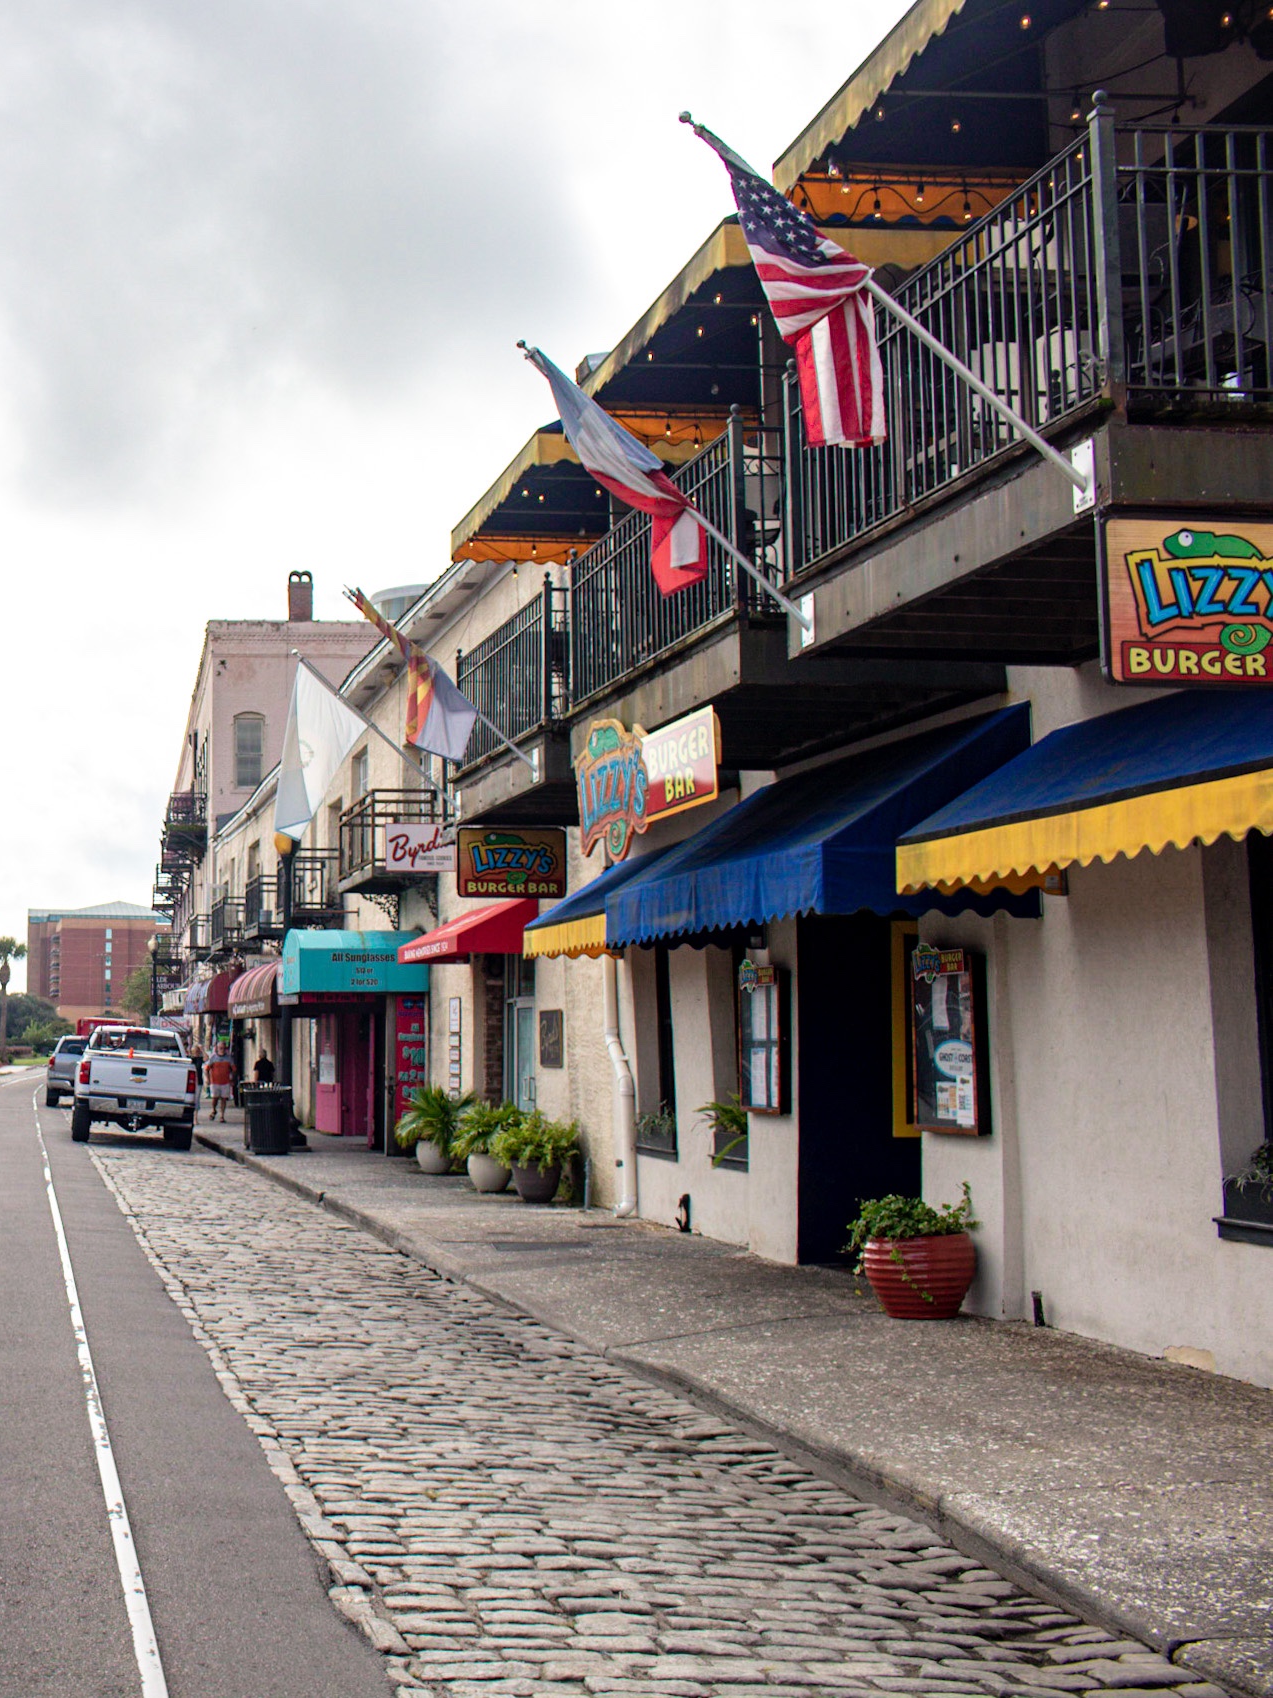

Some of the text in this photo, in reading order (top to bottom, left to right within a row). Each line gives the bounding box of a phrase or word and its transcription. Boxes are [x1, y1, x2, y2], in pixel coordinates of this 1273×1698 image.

[1128, 646, 1268, 676] BURGER
[646, 724, 710, 781] BURGER
[579, 747, 647, 835] LIZZY'S
[664, 766, 696, 804] BAR
[471, 844, 553, 875] LIZZY'S
[466, 881, 559, 894] BURGER BAR
[331, 952, 396, 964] All Sunglasses
